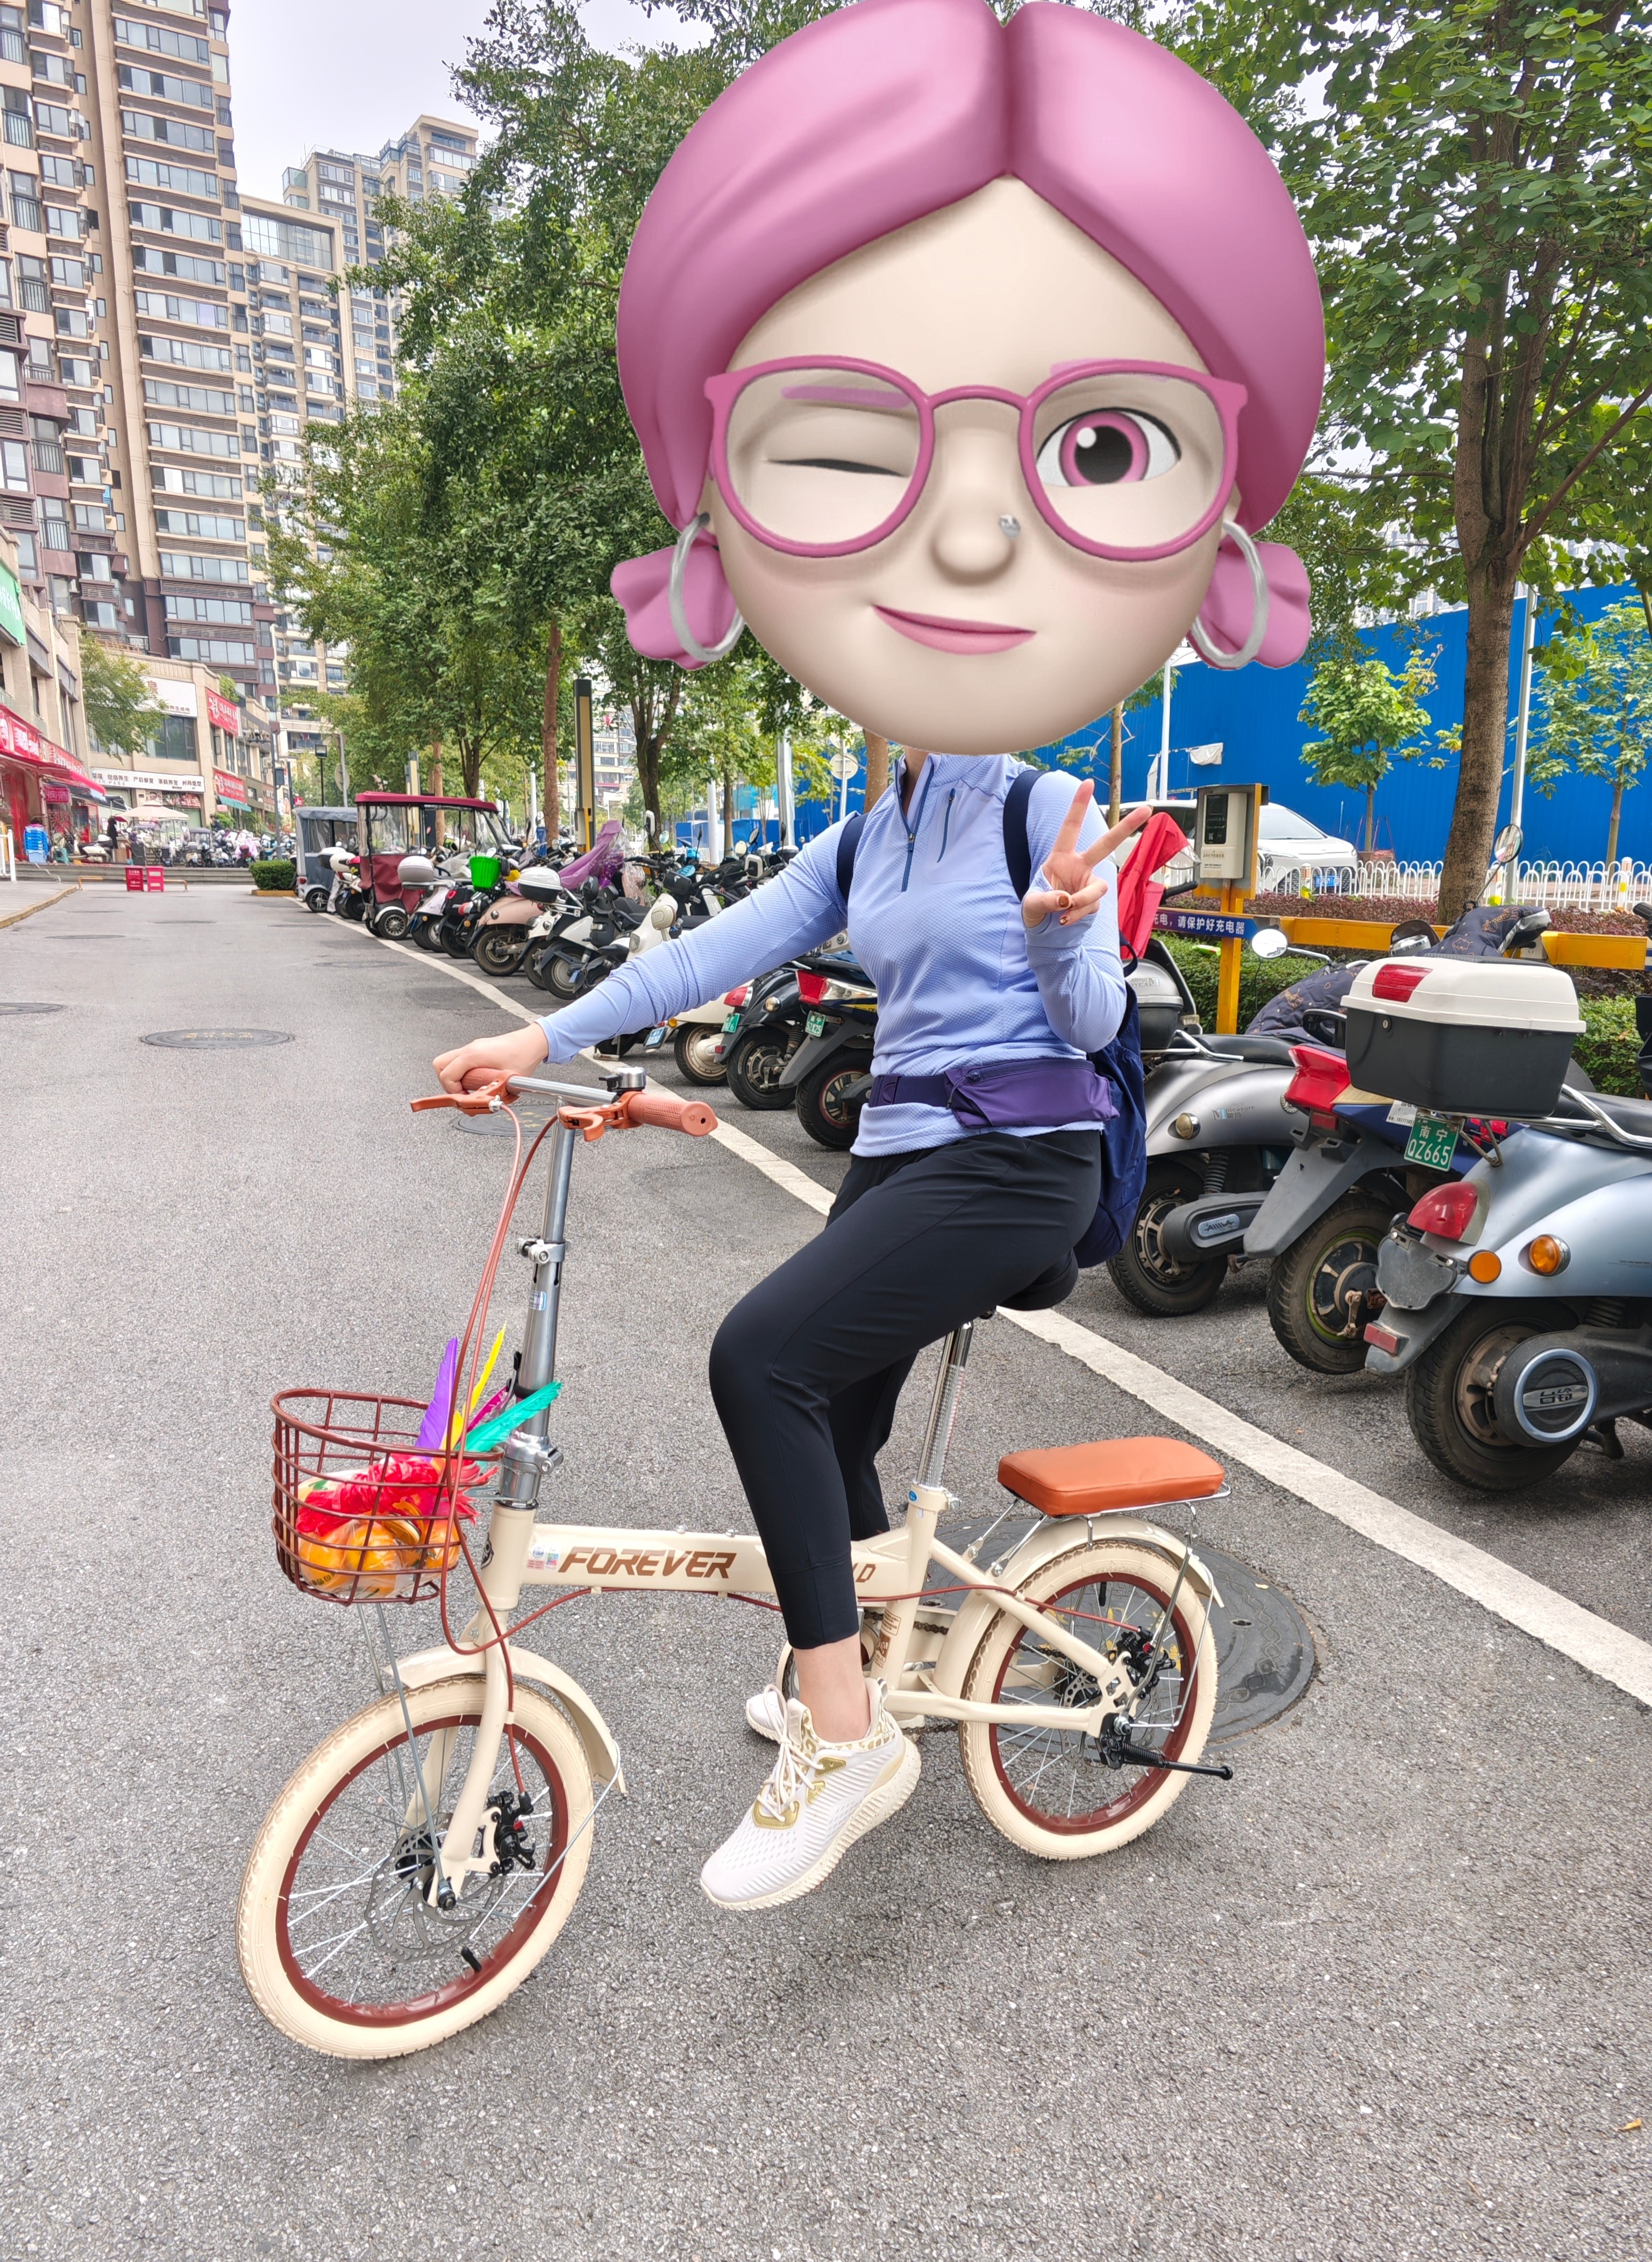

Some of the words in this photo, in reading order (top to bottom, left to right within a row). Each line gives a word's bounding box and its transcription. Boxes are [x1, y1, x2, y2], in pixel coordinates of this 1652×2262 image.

[1419, 1125, 1448, 1142] 南宁
[1407, 1139, 1451, 1165] QZ665
[1540, 1388, 1572, 1404] 台铃
[558, 1546, 737, 1579] FOREVER
